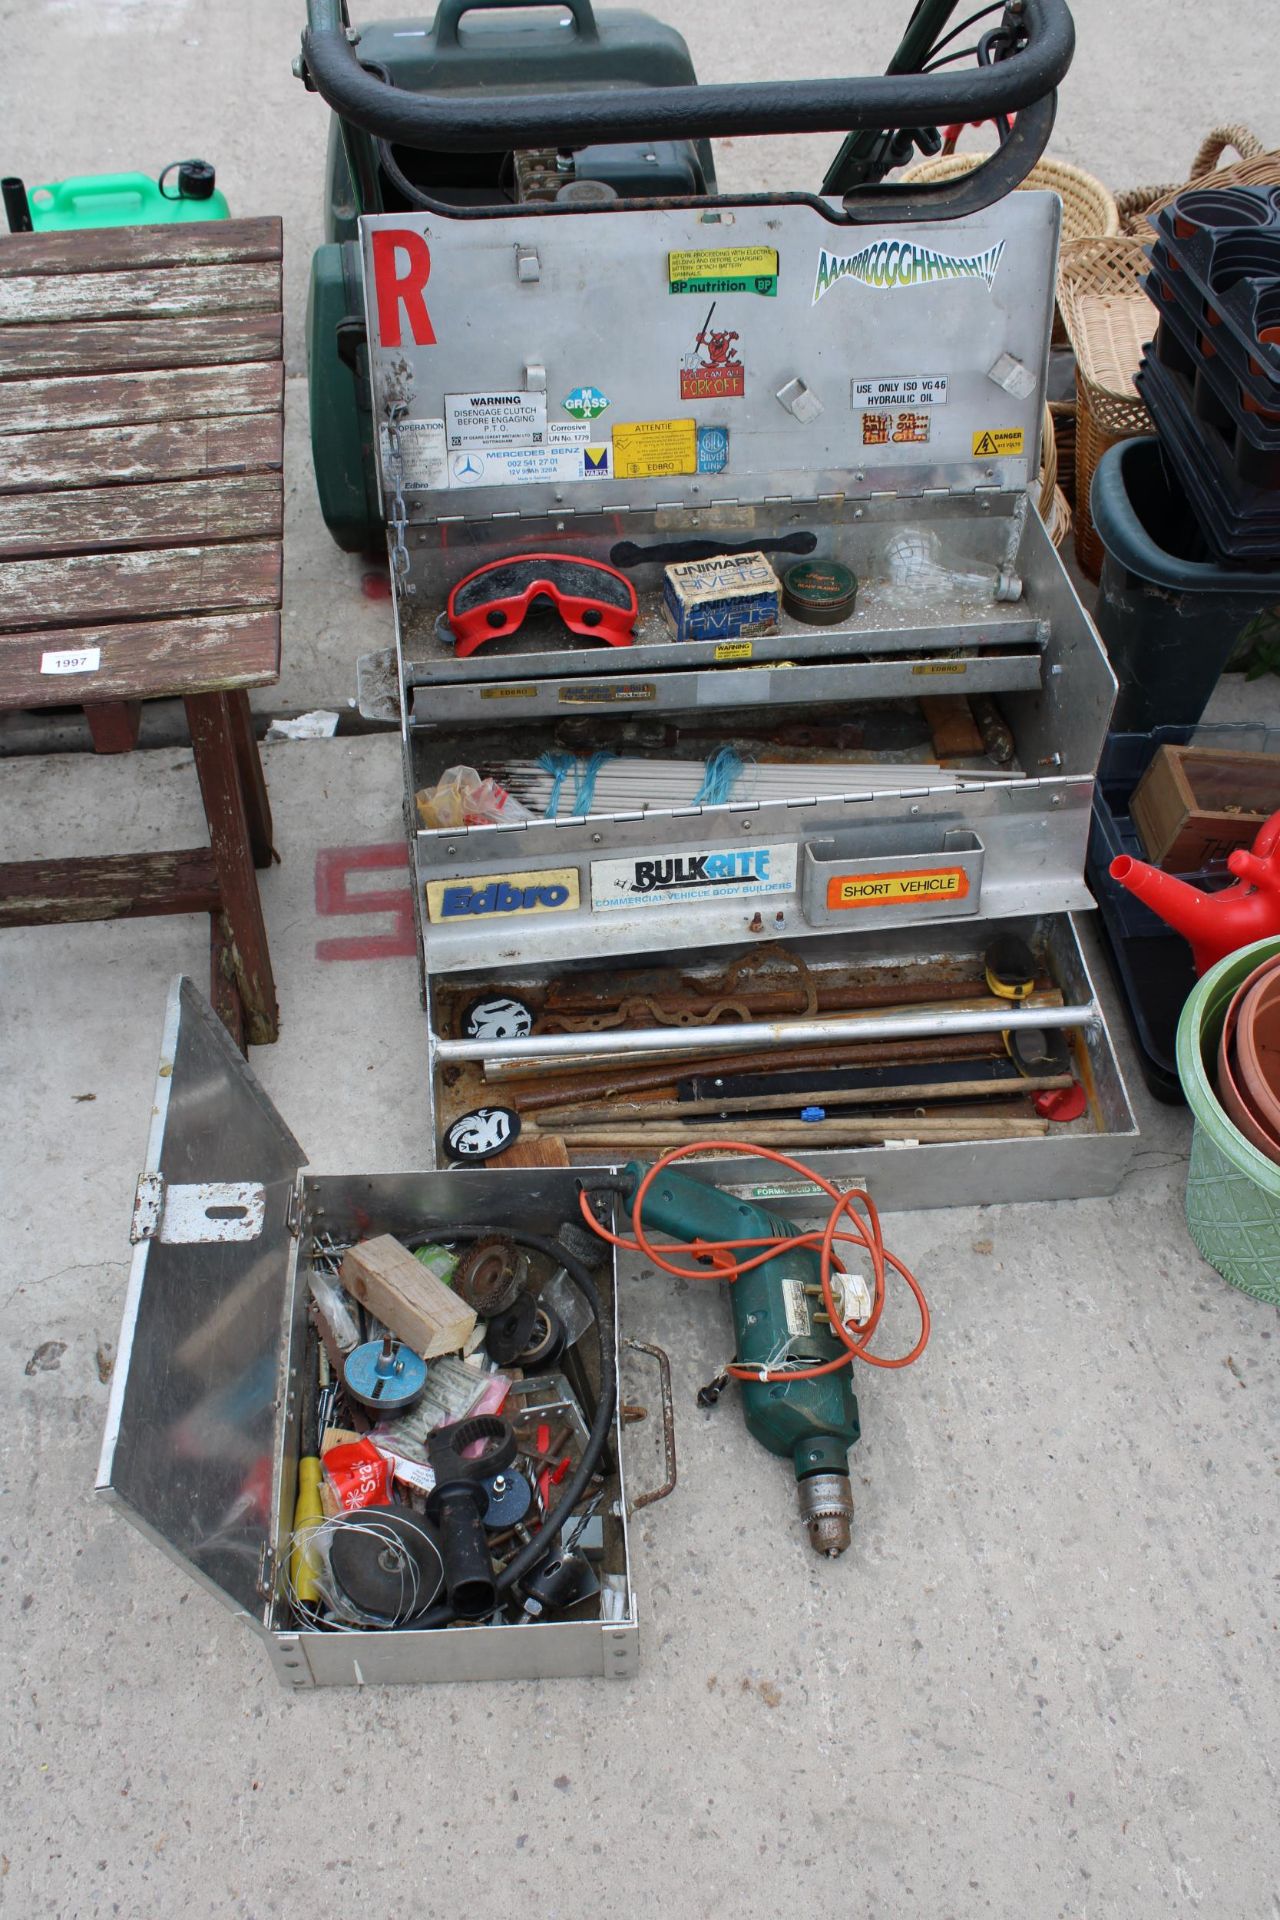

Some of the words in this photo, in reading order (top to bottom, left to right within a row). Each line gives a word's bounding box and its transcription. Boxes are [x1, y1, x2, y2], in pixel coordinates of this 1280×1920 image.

[371, 229, 437, 347] R
[672, 281, 688, 293] BP
[689, 281, 746, 292] nutrition
[759, 279, 771, 290] BP
[683, 379, 713, 395] FORK
[714, 377, 741, 393] OFF
[856, 384, 872, 394] USE
[878, 384, 899, 392] ONLY
[904, 382, 917, 391] ISO
[922, 381, 933, 390] VG
[934, 380, 946, 389] 46
[470, 396, 521, 406] WARNING
[565, 398, 608, 409] GRASS
[867, 394, 915, 405] HYDRAULIC
[920, 394, 933, 402] OIL
[454, 409, 502, 418] DISENGAGE
[503, 407, 537, 415] CLUTCH
[457, 418, 489, 426] BEFORE
[491, 416, 535, 424] ENGAGING
[398, 423, 443, 432] OPERATION
[635, 422, 673, 432] ATTENTIE
[549, 434, 560, 442] UN
[994, 432, 1021, 440] DANGER
[647, 462, 674, 471] EDBRO
[404, 482, 429, 490] Edbro
[674, 555, 763, 576] UNIMARK
[679, 566, 769, 592] RIVETS
[56, 657, 87, 668] 1997
[635, 850, 770, 893] BULKRITE
[844, 884, 891, 897] SHORT
[900, 878, 956, 893] VEHICLE
[441, 882, 569, 917] Edbro
[595, 895, 664, 907] COMMERCIAL
[667, 890, 710, 901] VEHICLE
[713, 887, 739, 896] BODY
[742, 882, 792, 893] BUILDERS
